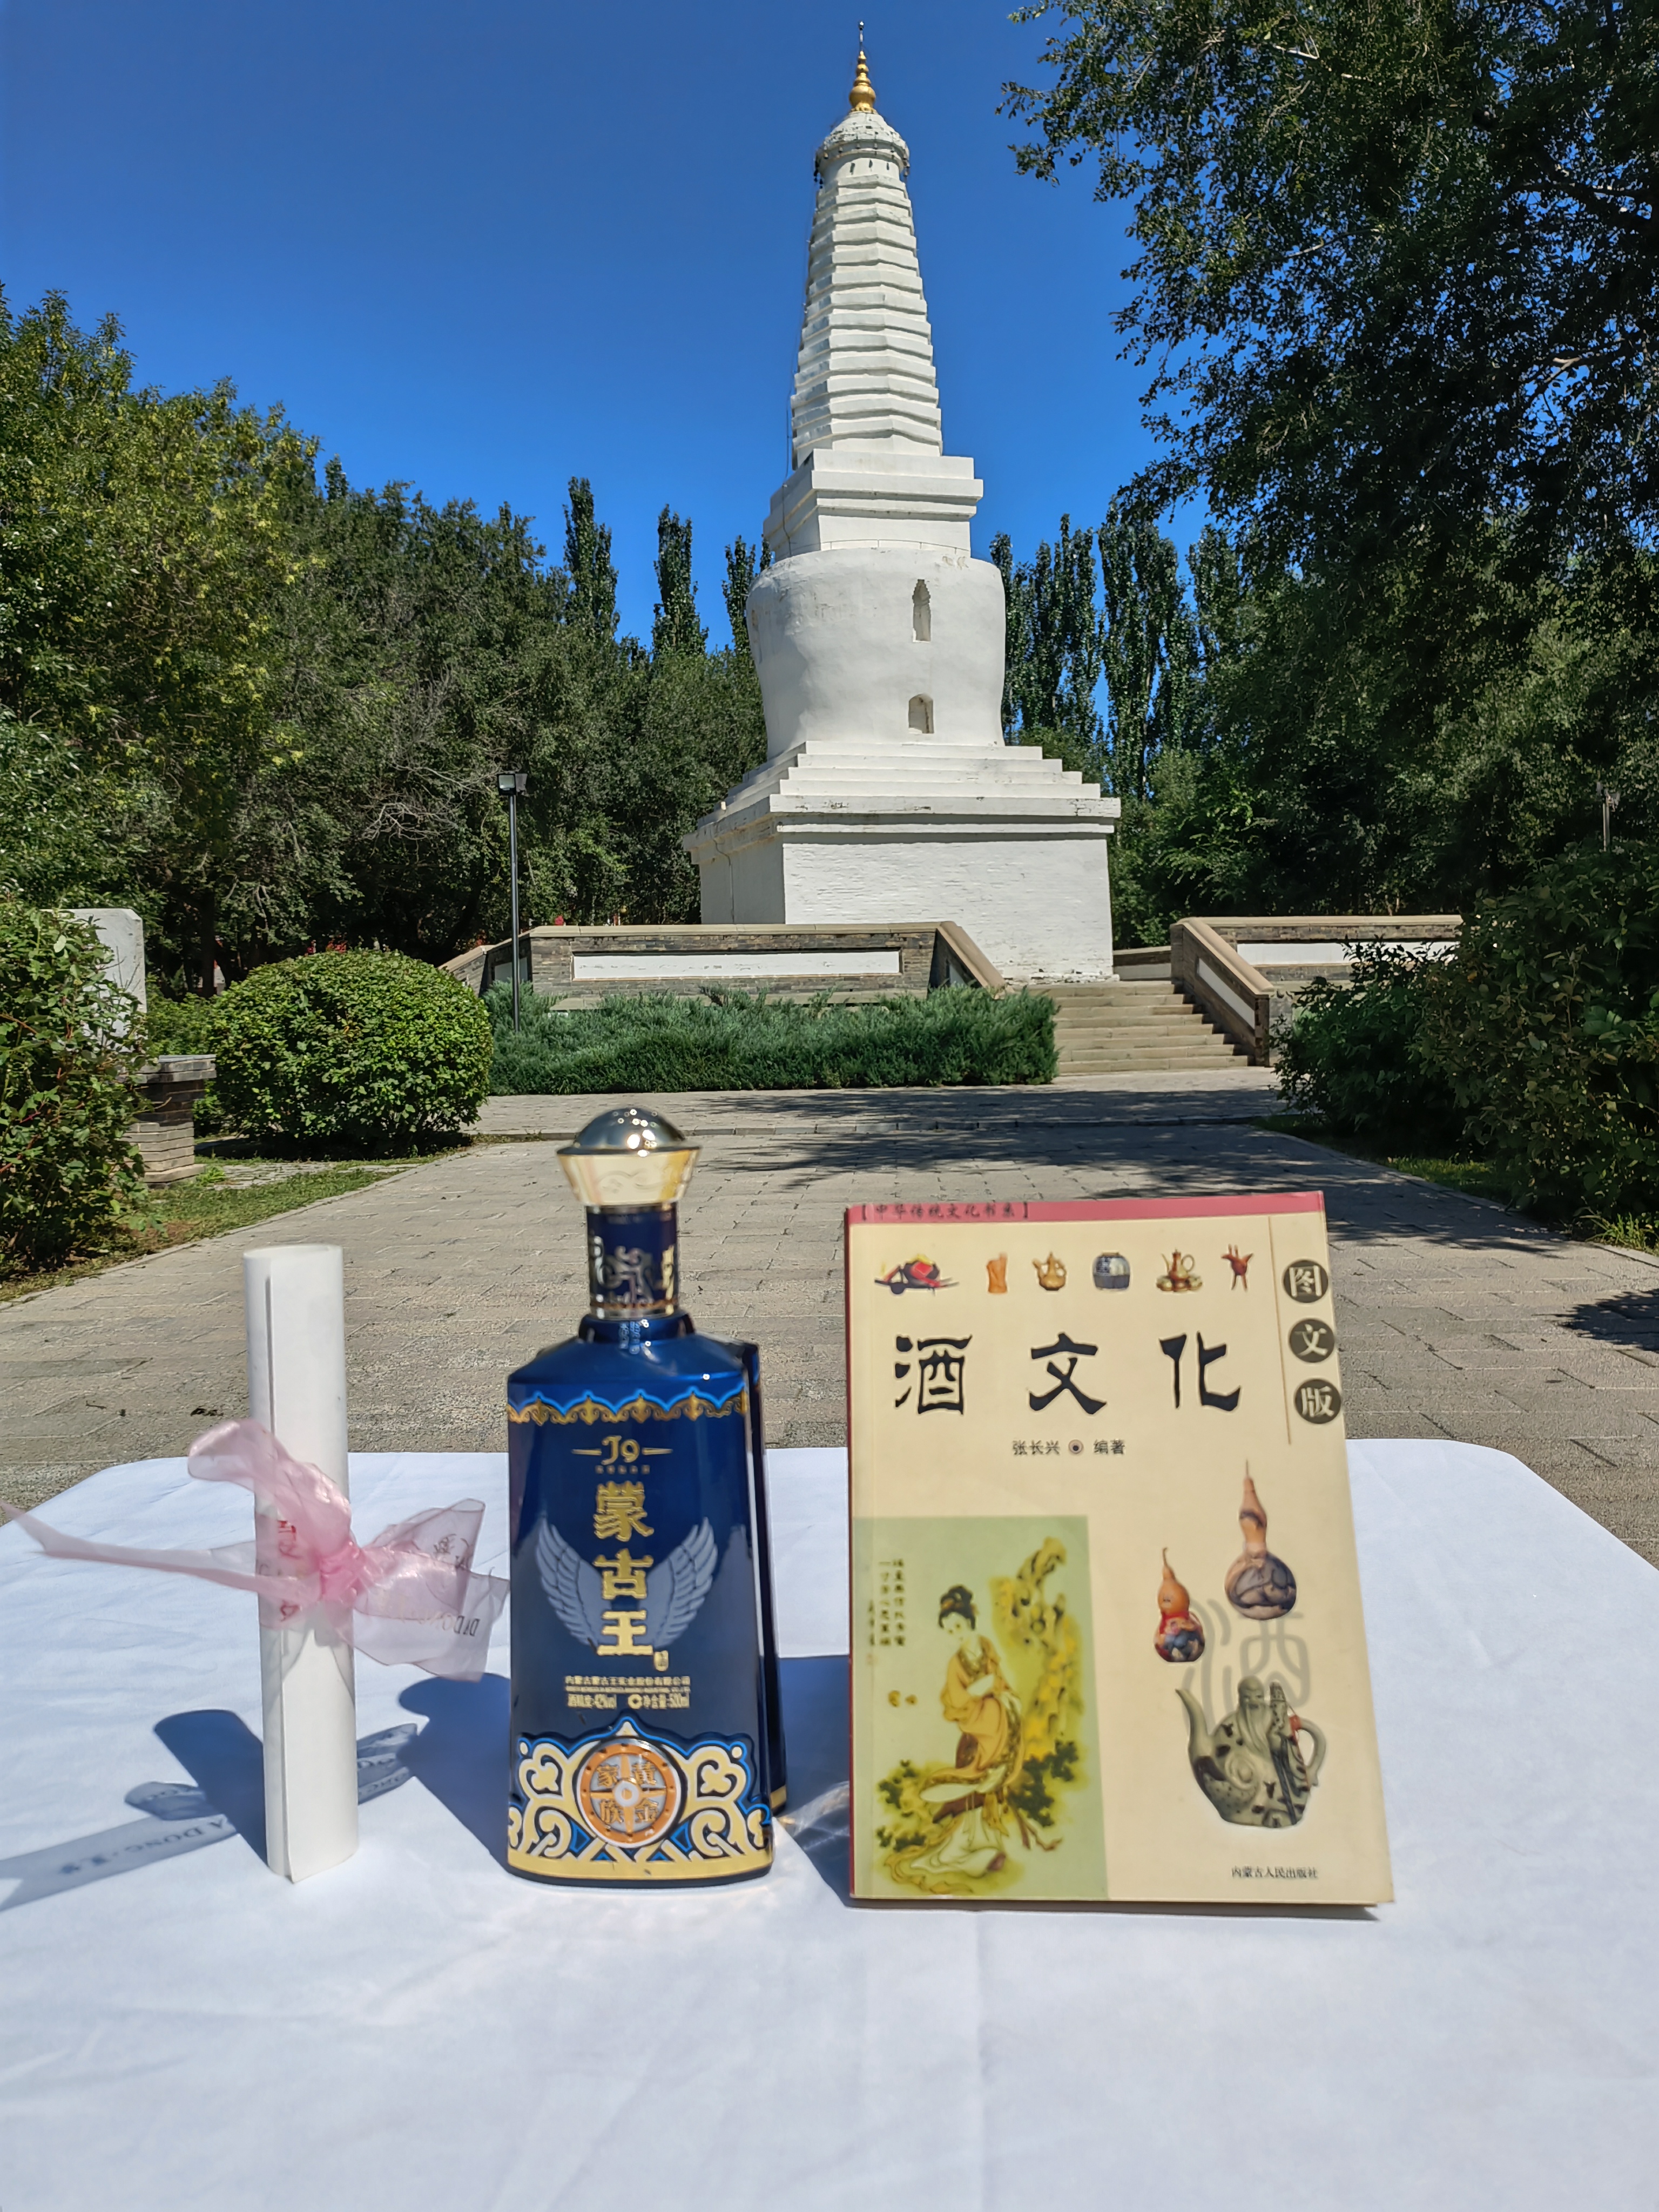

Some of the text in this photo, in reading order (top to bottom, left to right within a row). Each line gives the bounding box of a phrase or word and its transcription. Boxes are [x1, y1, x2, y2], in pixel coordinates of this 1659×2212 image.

[895, 1331, 1242, 1415] 酒文化
[1285, 1263, 1338, 1420] 图文版
[1013, 1439, 1125, 1455] 张长兴 编著
[593, 1480, 654, 1656] 蒙古王
[1231, 1865, 1317, 1879] 内蒙古人民出版社
